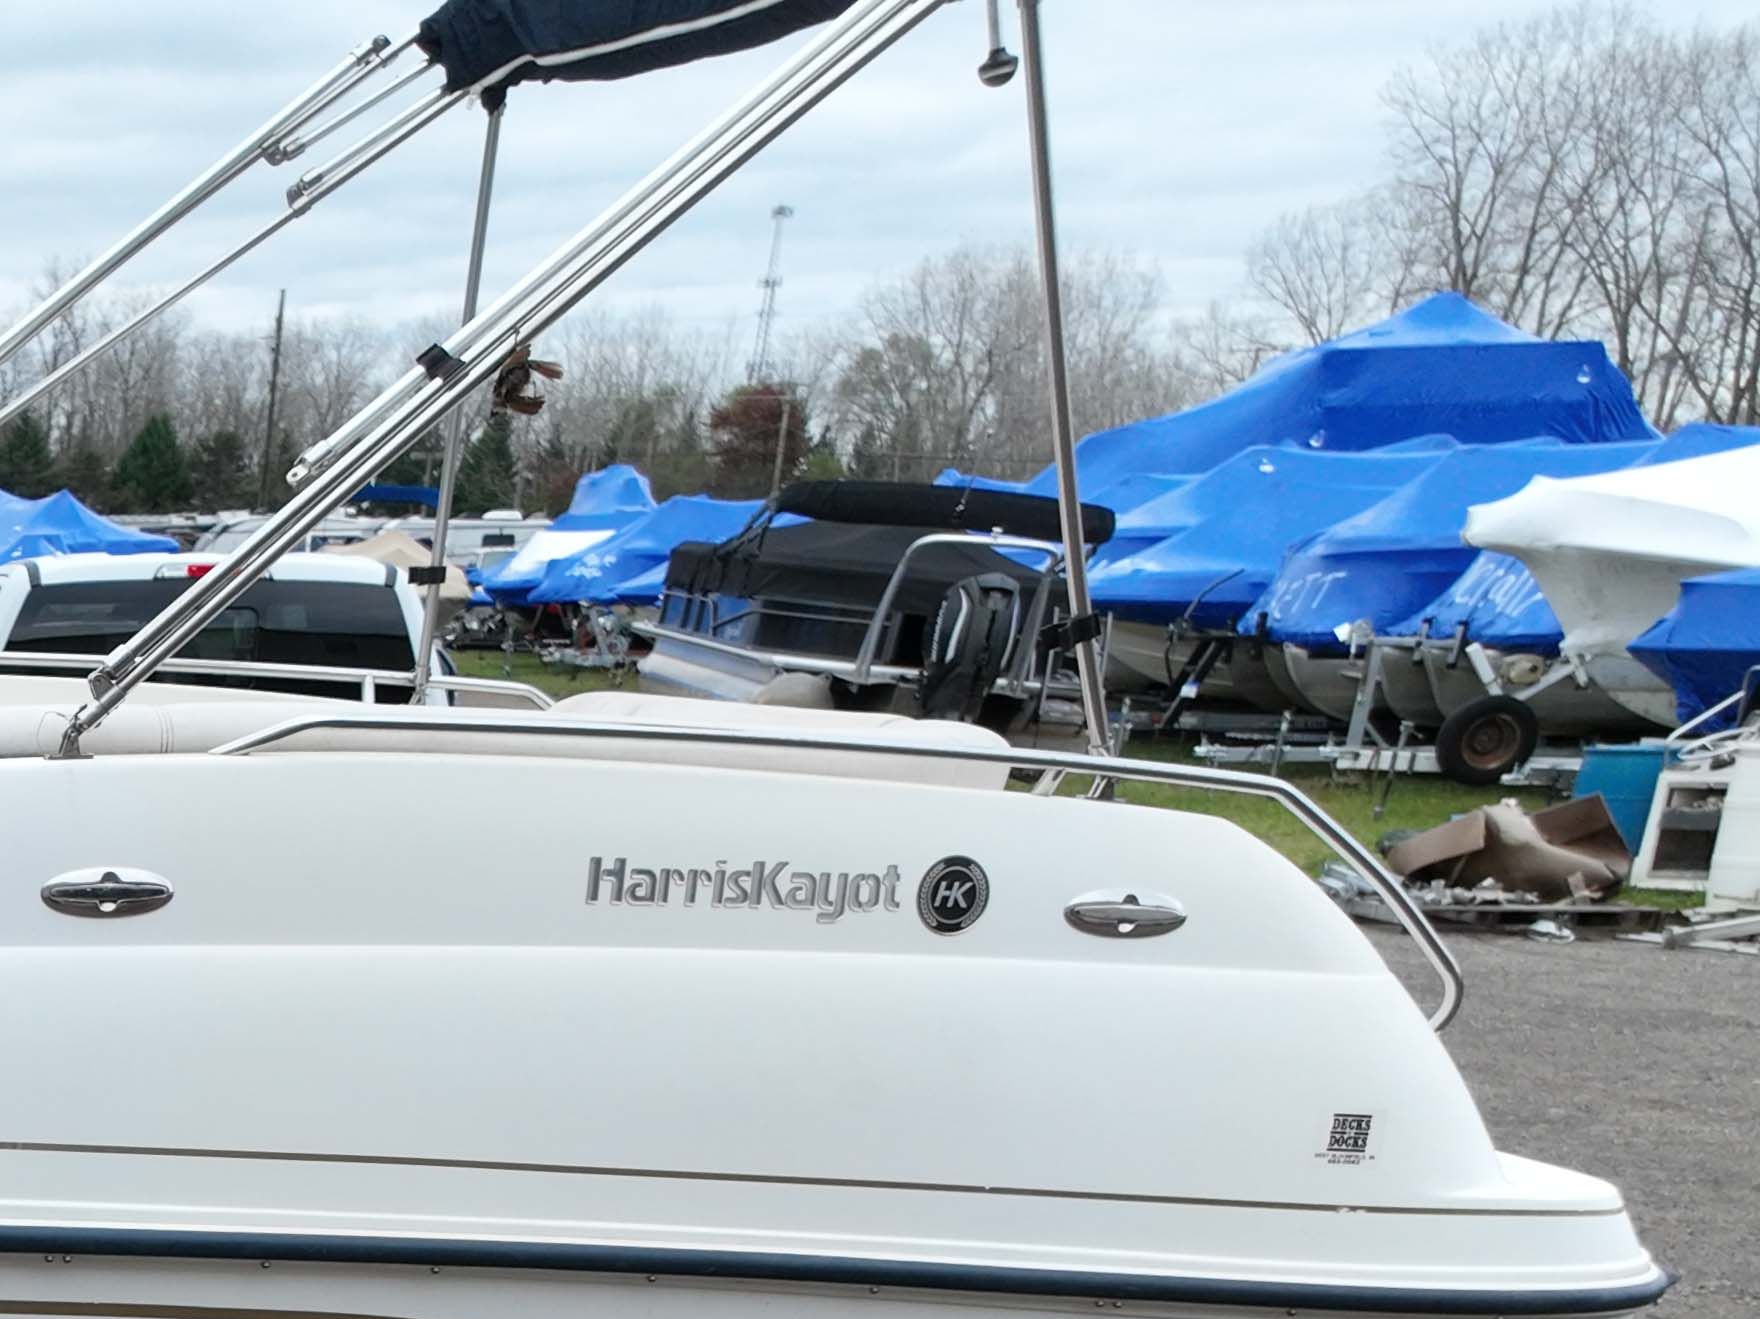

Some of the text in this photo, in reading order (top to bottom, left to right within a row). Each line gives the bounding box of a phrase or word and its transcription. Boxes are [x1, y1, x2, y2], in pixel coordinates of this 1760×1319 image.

[585, 856, 902, 924] HarrisKayot
[934, 881, 972, 908] HK
[1332, 1118, 1372, 1131] DECKS
[1328, 1135, 1368, 1148] DOCKS
